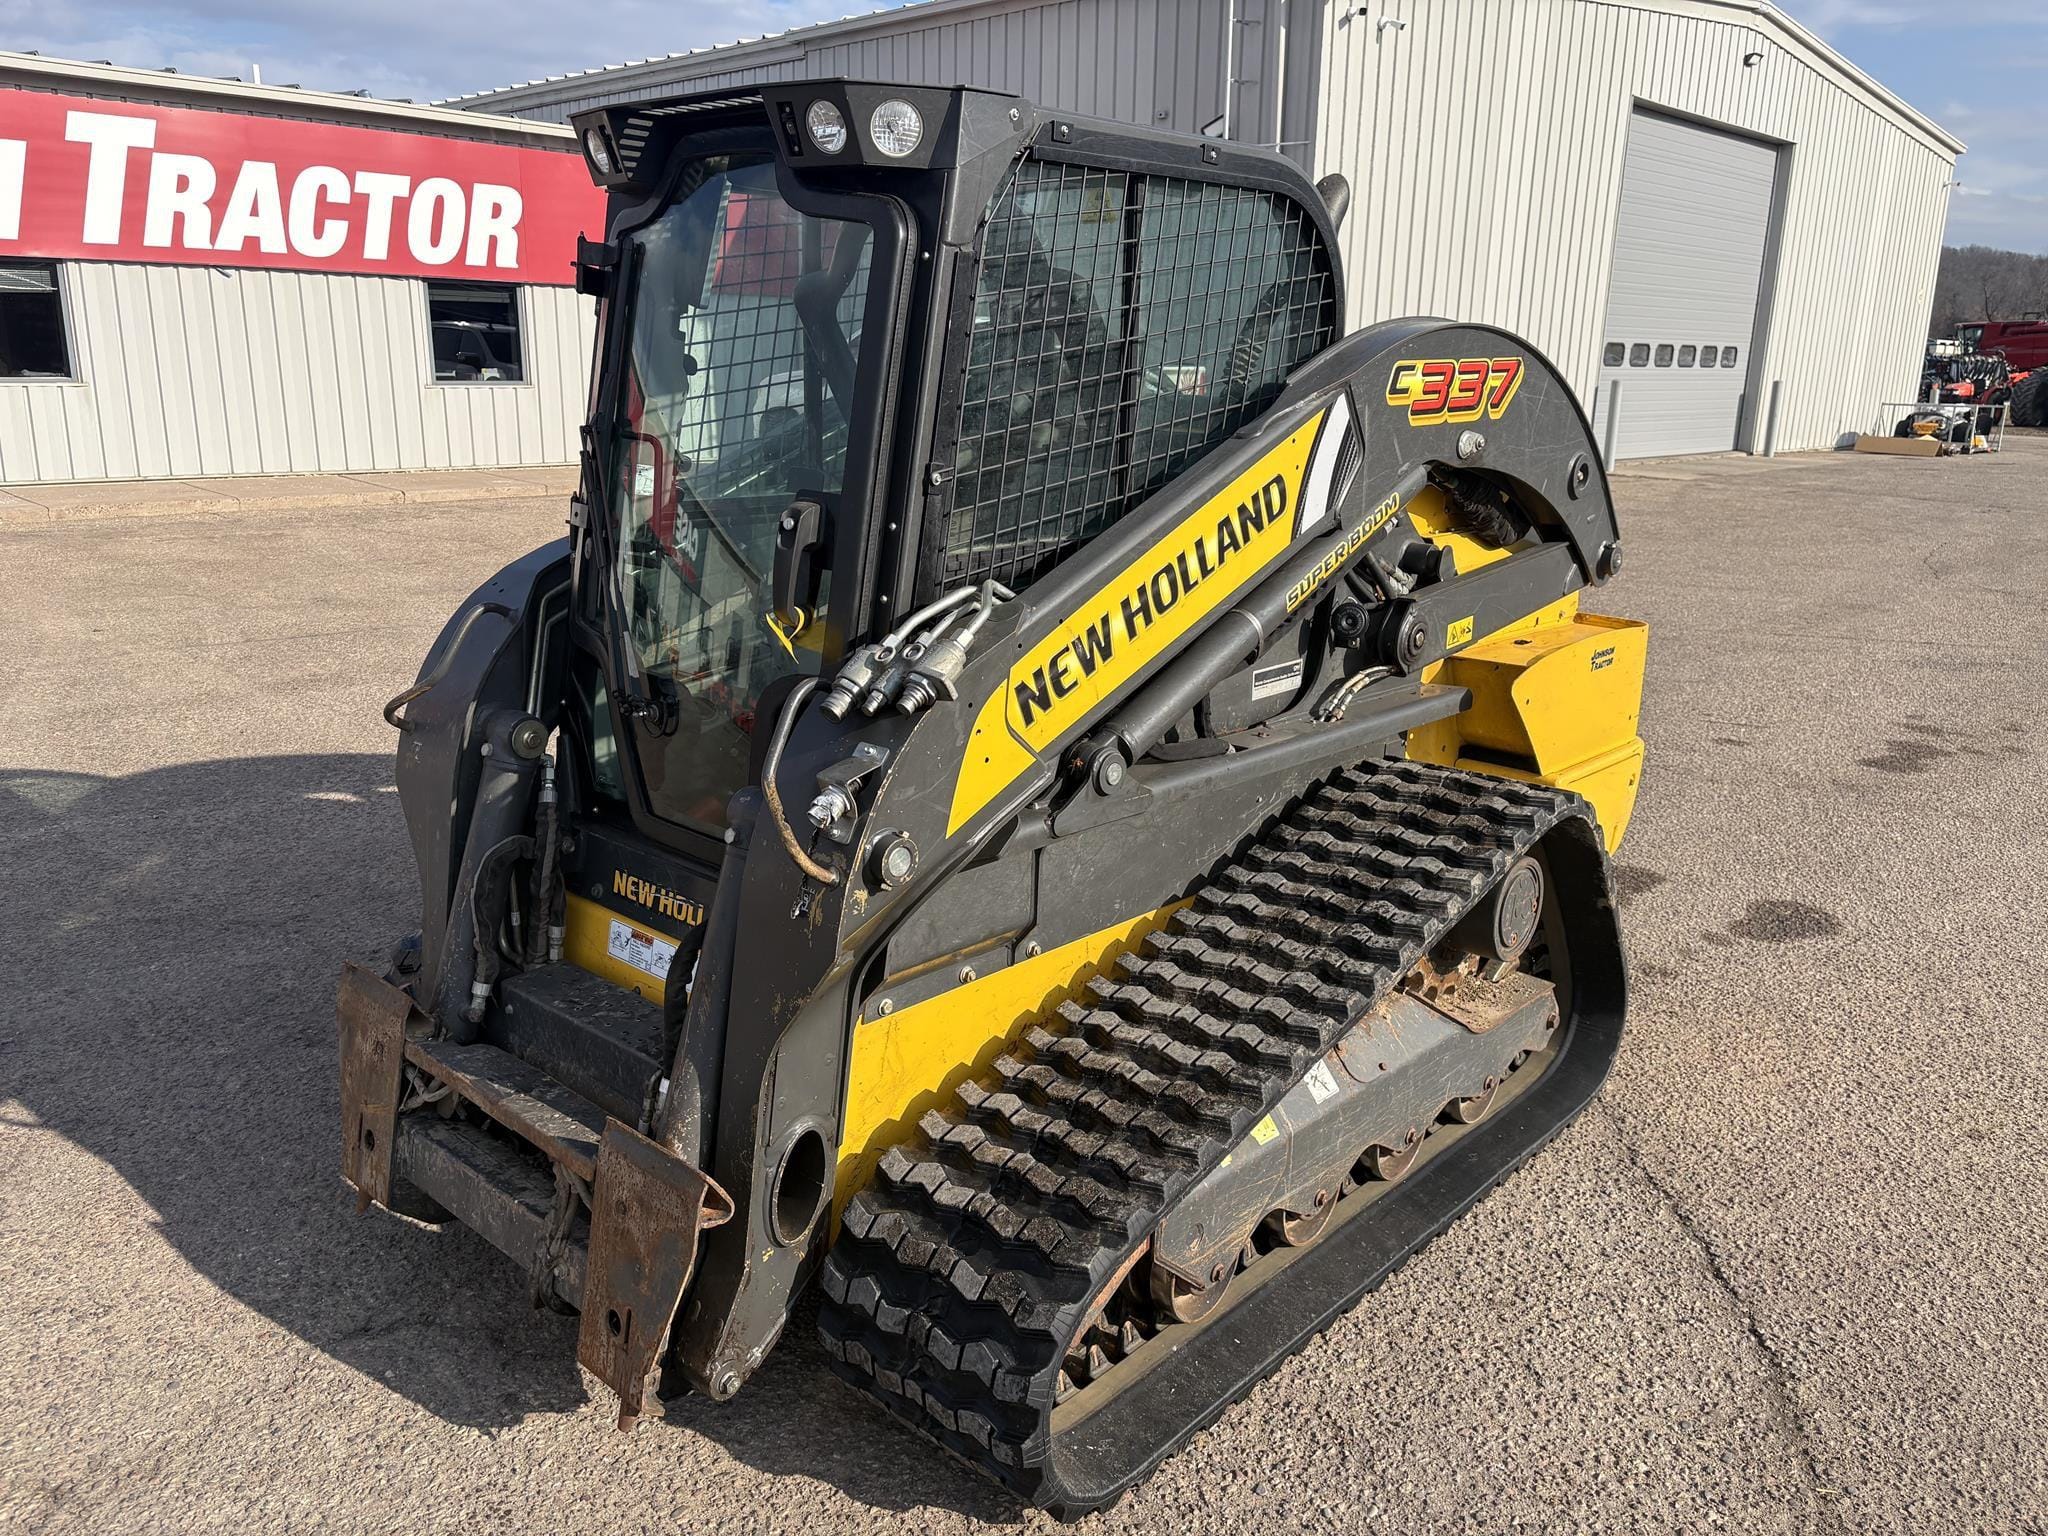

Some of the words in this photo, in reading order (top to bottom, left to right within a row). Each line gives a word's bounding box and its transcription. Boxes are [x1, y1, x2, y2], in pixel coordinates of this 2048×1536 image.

[65, 110, 523, 269] TRACTOR
[1386, 357, 1525, 426] C337
[1014, 610, 1113, 728] NEW
[1120, 473, 1287, 642] HOLLAND
[1286, 541, 1348, 613] SUPER
[1348, 492, 1400, 553] BOOM
[613, 869, 656, 908] NEW
